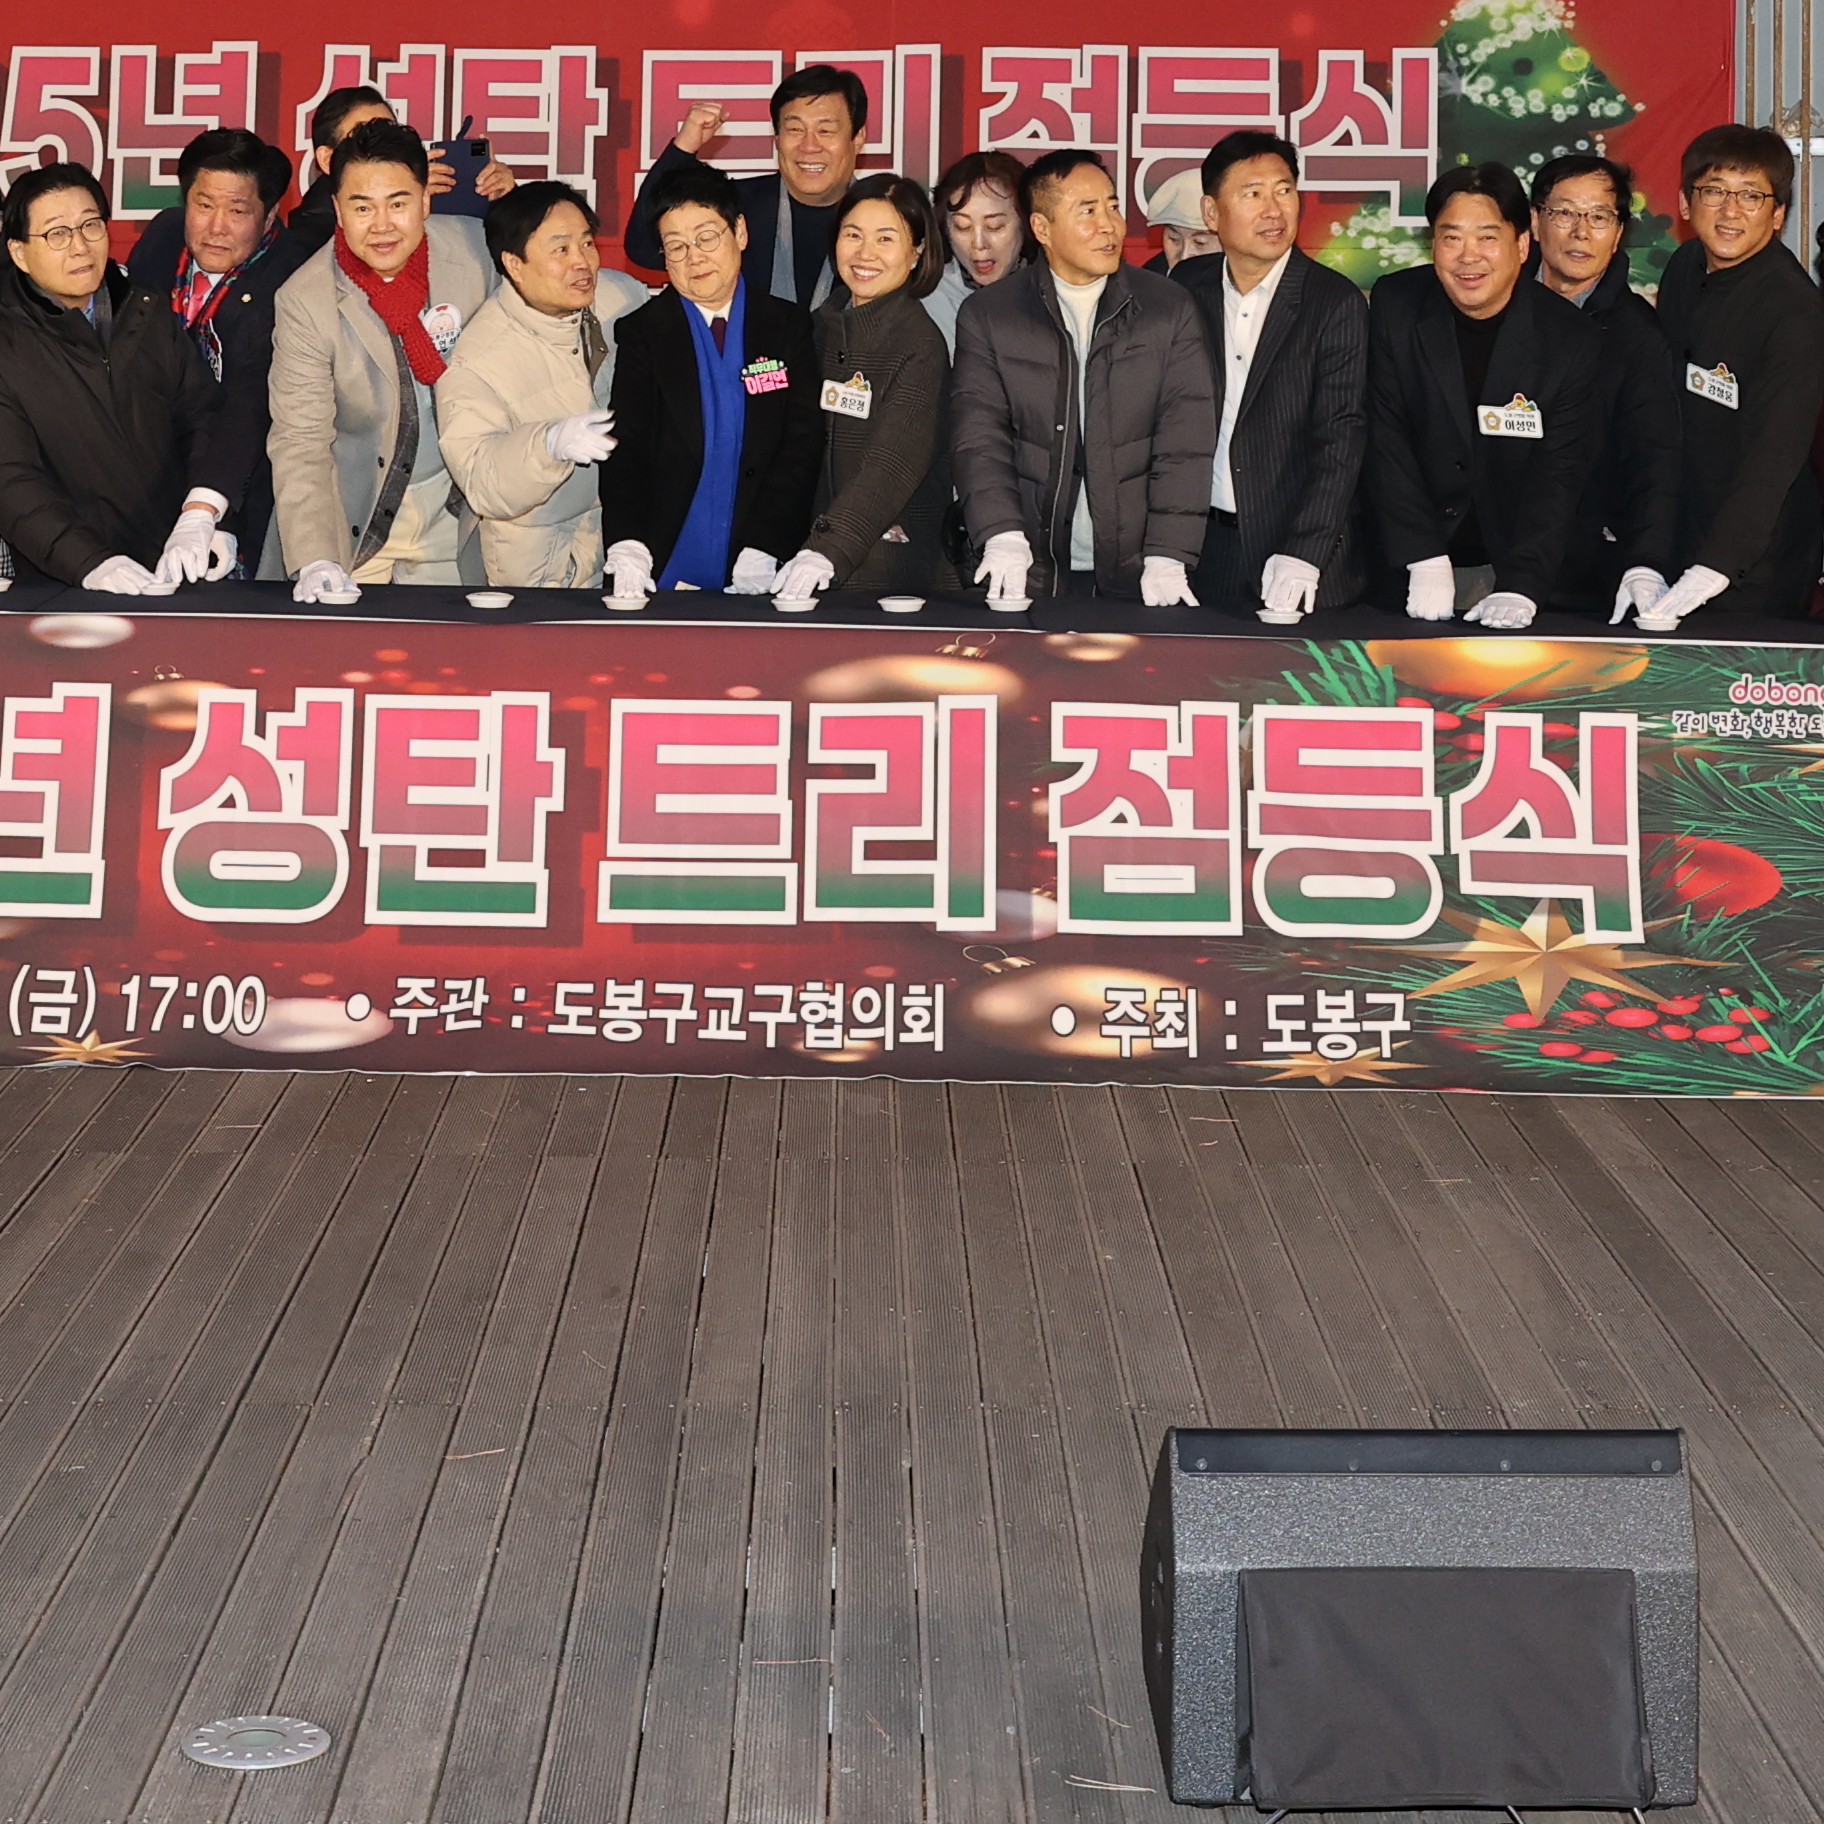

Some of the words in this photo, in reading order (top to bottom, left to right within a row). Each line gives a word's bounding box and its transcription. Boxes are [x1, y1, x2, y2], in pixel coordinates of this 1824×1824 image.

[840, 396, 865, 413] 홍은정
[1504, 419, 1537, 433] 이성민
[1674, 711, 1706, 734] 같이
[1711, 710, 1750, 740] 변화,
[1752, 710, 1806, 737] 행복한
[158, 685, 566, 929] 성탄
[596, 693, 998, 933] 트리
[1049, 695, 1646, 945] 점등식
[8, 964, 94, 1037] (금)
[120, 975, 268, 1036] 17:00
[390, 977, 489, 1034] 주관
[547, 979, 945, 1052] 도봉구교구협의회
[1100, 987, 1198, 1058] 주최
[1262, 988, 1411, 1059] 도봉구
